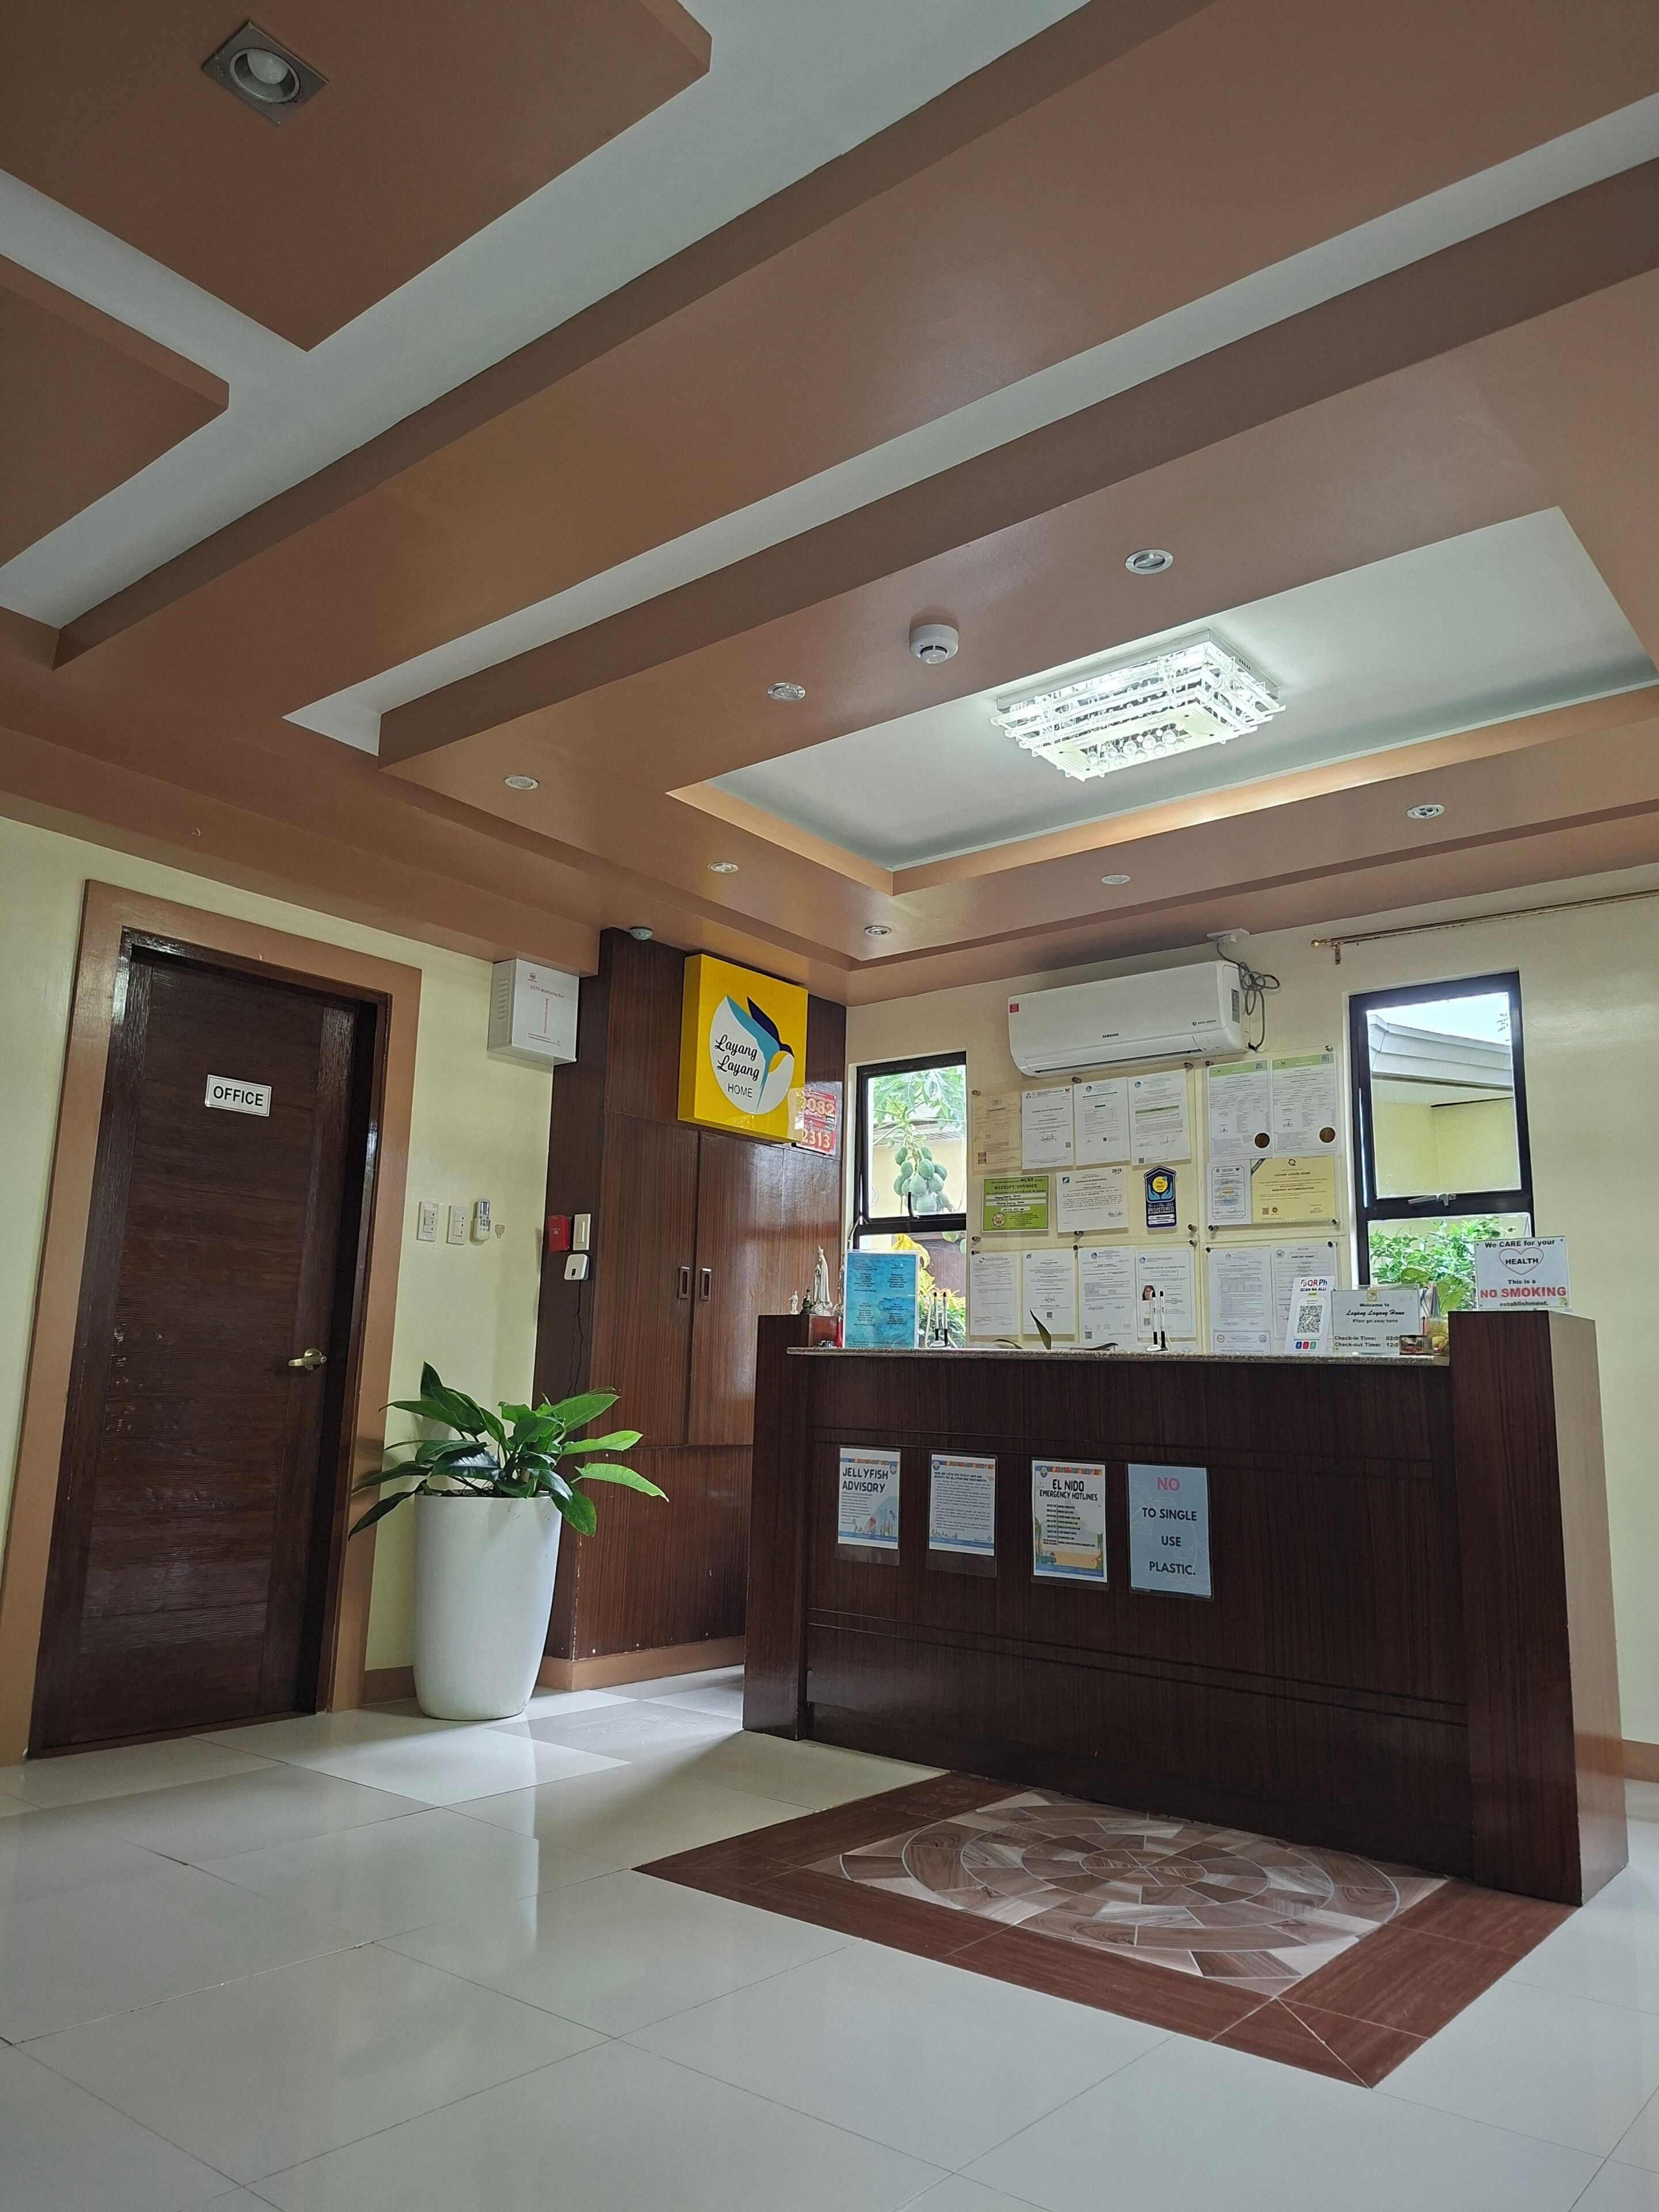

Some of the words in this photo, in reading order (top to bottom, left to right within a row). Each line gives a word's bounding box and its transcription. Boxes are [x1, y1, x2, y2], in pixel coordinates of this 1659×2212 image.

[714, 1034, 758, 1061] Layang
[716, 1055, 760, 1082] Layang
[213, 1085, 264, 1107] OFFICE
[728, 1083, 753, 1098] HOME
[802, 1130, 831, 1149] 2313
[1537, 1239, 1555, 1247] your
[1480, 1290, 1498, 1298] NO
[1501, 1286, 1567, 1298] SMOKING
[842, 1467, 888, 1480] JELLYFISH
[842, 1480, 886, 1493] ADVISORY
[1052, 1479, 1062, 1490] EL
[1064, 1480, 1085, 1492] NIDO
[1157, 1476, 1180, 1491] NO
[1039, 1489, 1071, 1499] EMERGENCY
[1071, 1492, 1098, 1501] HOTLINES
[1142, 1507, 1157, 1518] TO
[1159, 1508, 1197, 1521] SINGLE
[1161, 1535, 1181, 1547] USE
[1149, 1561, 1196, 1575] PLASTIC.
